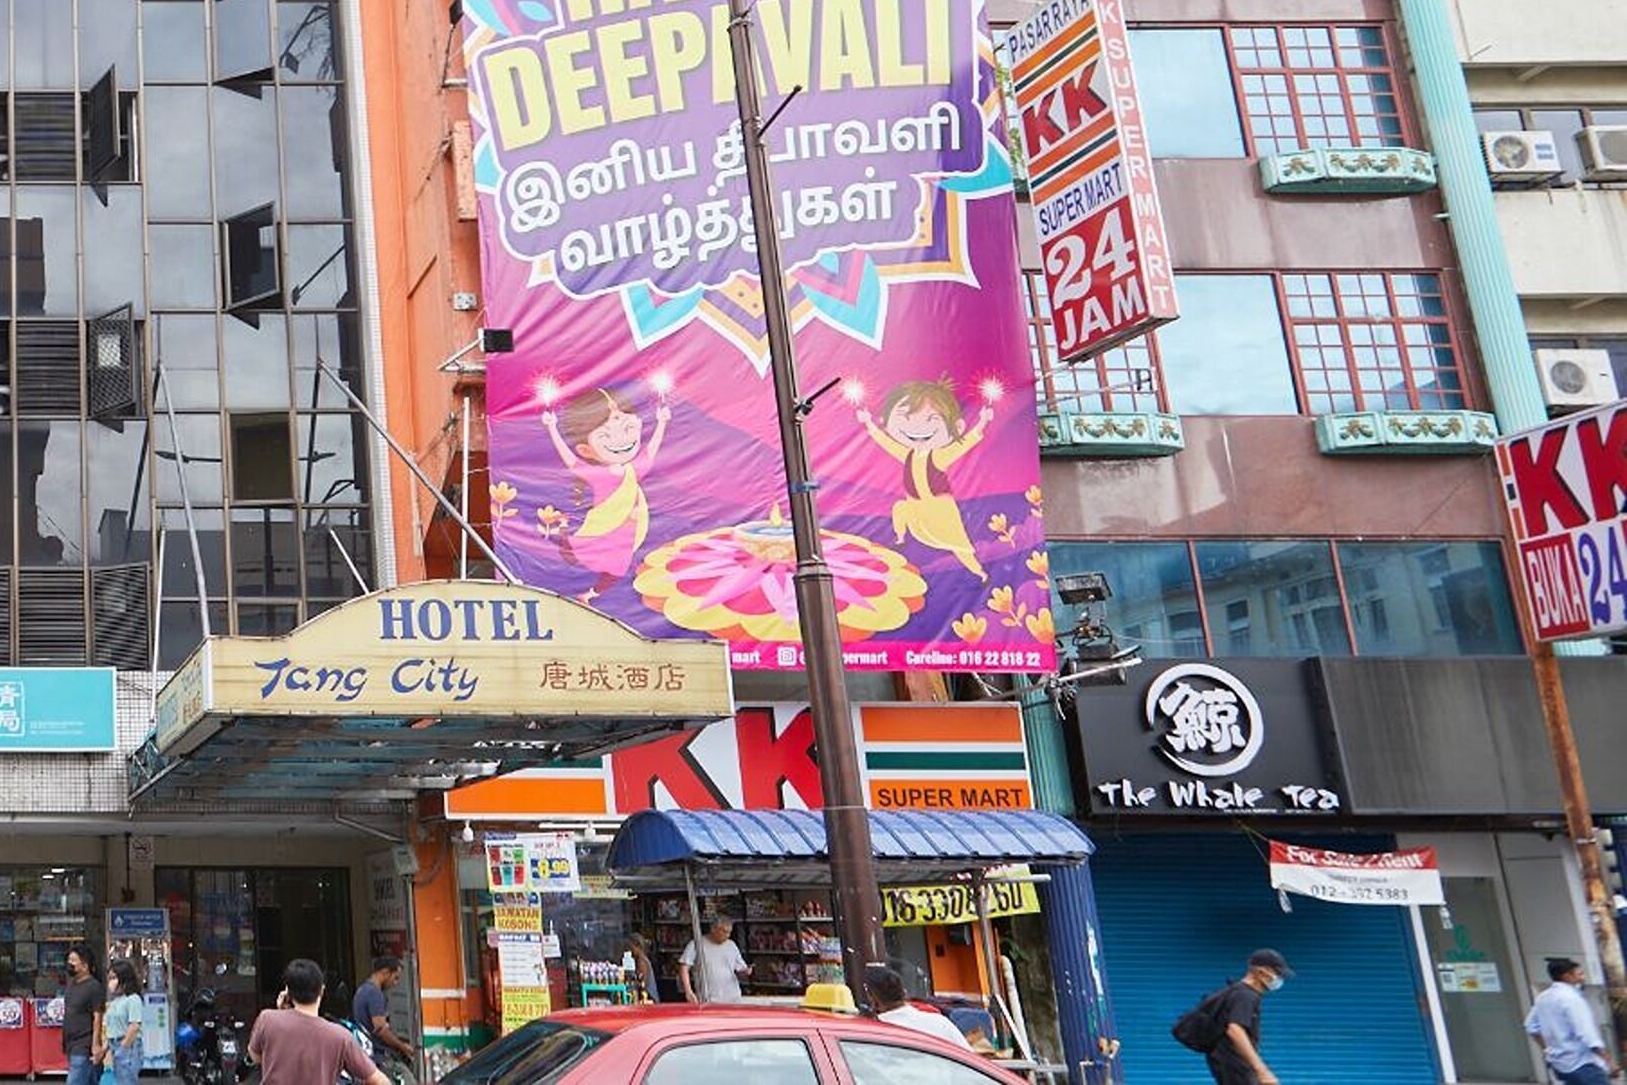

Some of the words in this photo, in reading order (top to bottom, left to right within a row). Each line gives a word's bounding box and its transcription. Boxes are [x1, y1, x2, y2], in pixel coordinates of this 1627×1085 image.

[1008, 10, 1052, 63] PASAR
[1022, 60, 1107, 159] KK
[1039, 191, 1083, 237] SUPER
[1085, 163, 1123, 207] MART
[1046, 208, 1136, 309] 24
[1060, 276, 1145, 351] JAM
[1509, 409, 1627, 538] KK
[1526, 543, 1586, 628] BUKA
[377, 599, 553, 641] HOTEL
[254, 658, 368, 701] Tang
[390, 657, 479, 701] City
[538, 661, 687, 693] 唐城酒店
[906, 651, 957, 665] Careline:
[878, 787, 955, 808] SUPER
[960, 787, 1024, 808] MART
[1098, 778, 1156, 807] The
[1169, 780, 1265, 809] Whale
[1281, 784, 1340, 809] Tea
[1286, 846, 1317, 865] For
